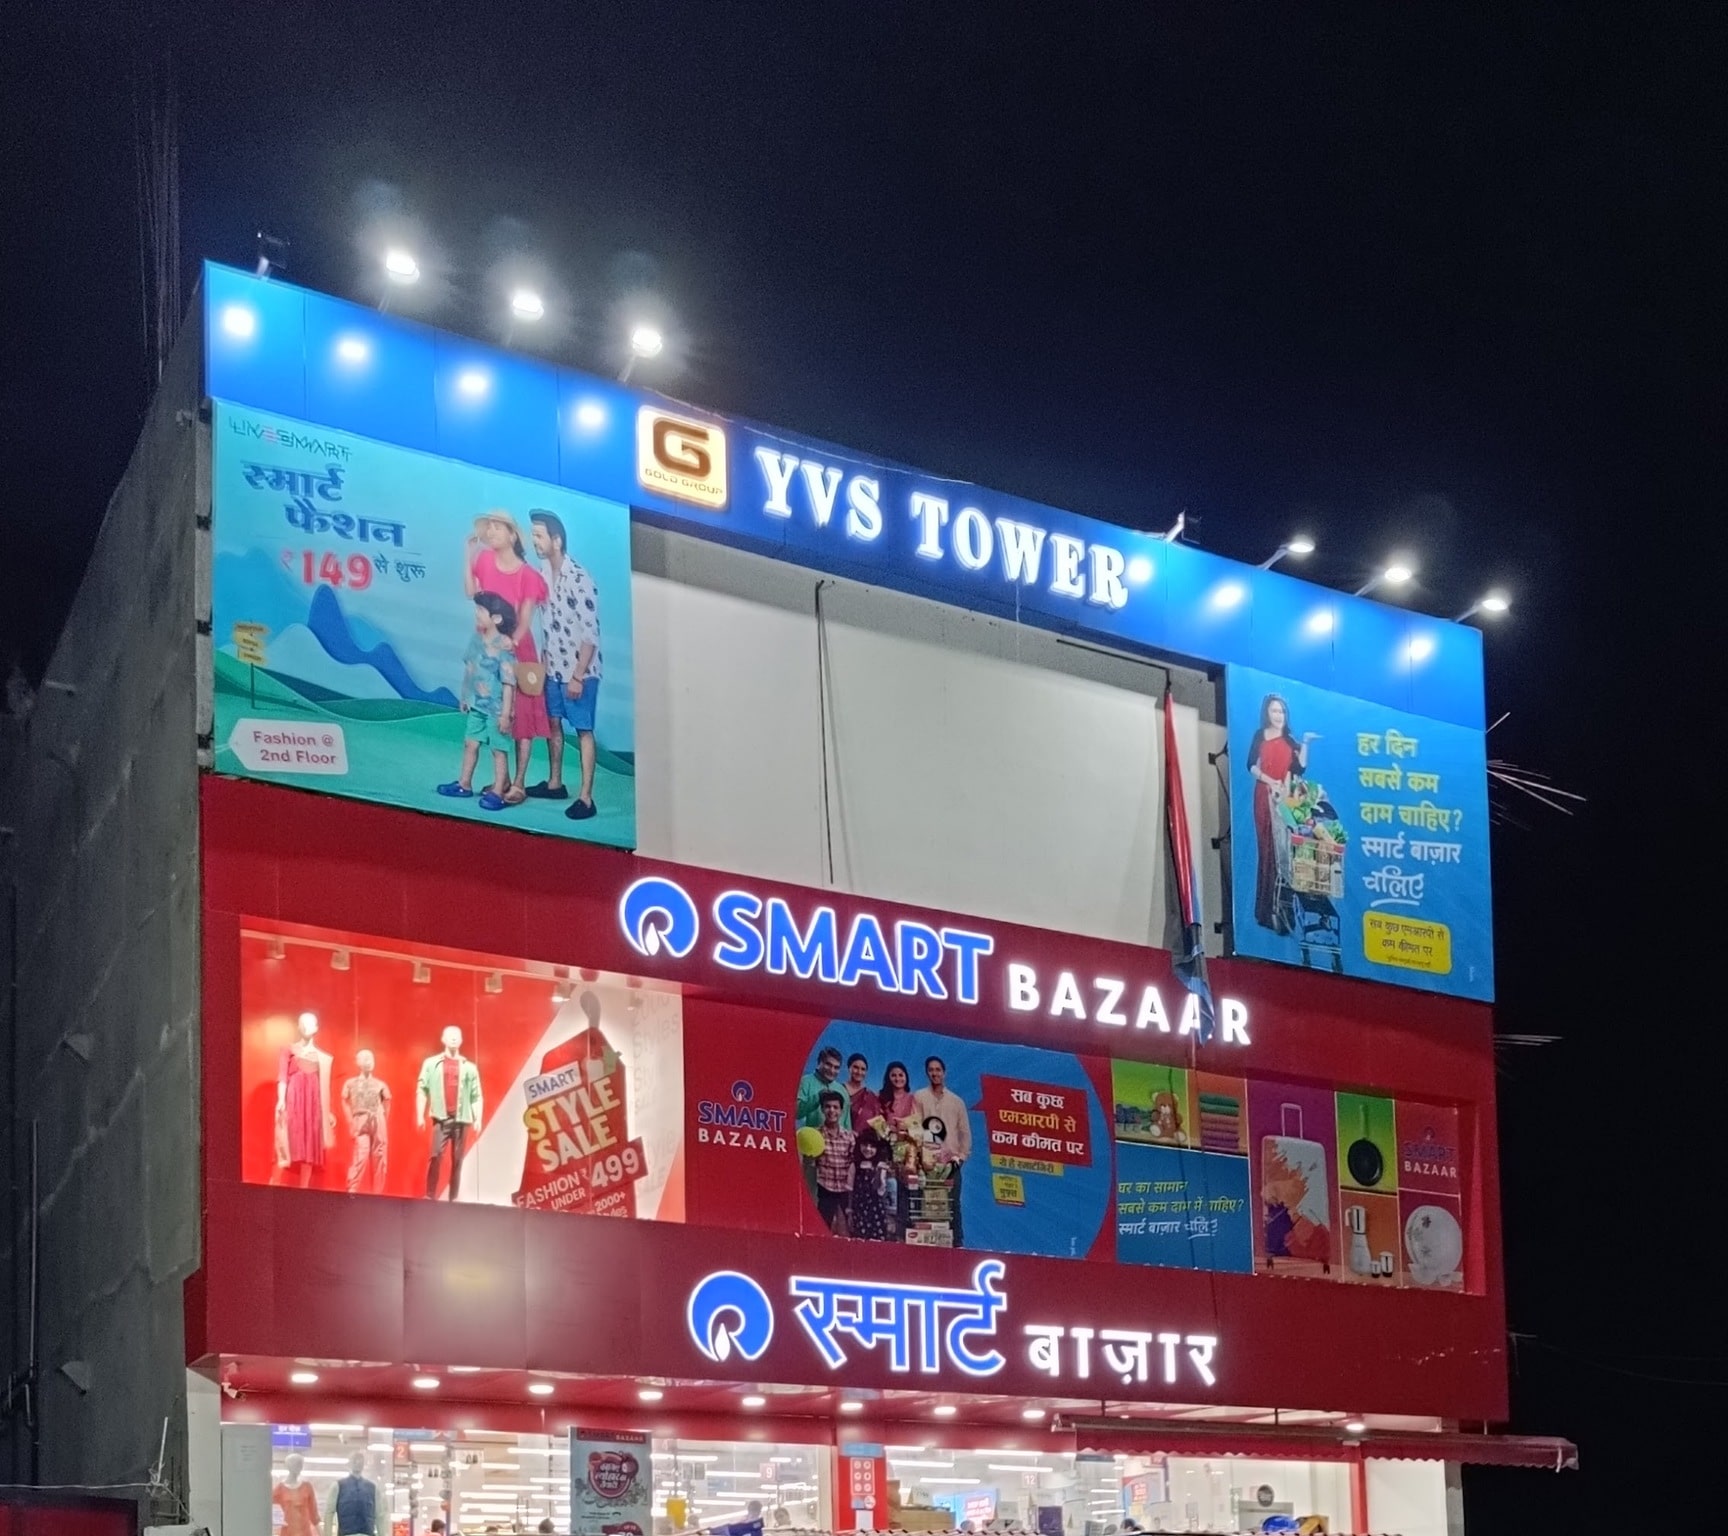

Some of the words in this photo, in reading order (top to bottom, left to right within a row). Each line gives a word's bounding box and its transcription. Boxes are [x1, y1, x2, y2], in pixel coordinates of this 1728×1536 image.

[240, 461, 345, 501] स्मार्ट
[645, 468, 678, 484] GOLD
[755, 446, 883, 542] YVS
[909, 491, 1130, 611] TOWER
[374, 553, 389, 574] से
[395, 559, 426, 582] शुरू
[253, 731, 316, 746] Fashion
[322, 734, 334, 747] @
[1357, 732, 1380, 756] हर
[1385, 728, 1418, 758] दिन
[260, 749, 290, 762] 2nd
[296, 751, 336, 764] Floor
[1358, 762, 1402, 790] सबसे
[1407, 772, 1440, 793] कम
[1360, 802, 1394, 824] दाम
[1361, 831, 1405, 859] स्मार्ट
[1362, 865, 1424, 899] चलिए
[713, 890, 994, 1004] SMART
[1008, 963, 1251, 1045] BAZAAR
[528, 1068, 575, 1099] SMART
[523, 1077, 621, 1142] STYLE
[1010, 1088, 1032, 1104] सब
[1036, 1092, 1064, 1109] कुछ
[698, 1100, 787, 1132] SMART
[999, 1109, 1059, 1130] एमआरपी
[1064, 1116, 1076, 1132] से
[536, 1114, 618, 1173] SALE
[698, 1128, 787, 1152] BAZAAR
[992, 1130, 1018, 1146] कम
[1021, 1132, 1061, 1152] कीमत
[1066, 1141, 1084, 1155] पर
[1404, 1160, 1457, 1178] BAZAAR
[516, 1171, 580, 1209] FASHION
[551, 1187, 586, 1211] UNDER
[1118, 1182, 1132, 1194] घर
[1136, 1182, 1151, 1193] का
[594, 1191, 626, 1212] 2000+
[1118, 1198, 1145, 1215] सबसे
[1148, 1201, 1168, 1213] कम
[1118, 1217, 1147, 1235] स्मार्ट
[789, 1259, 1007, 1377] स्मार्ट
[1024, 1324, 1218, 1386] बाज़ार
